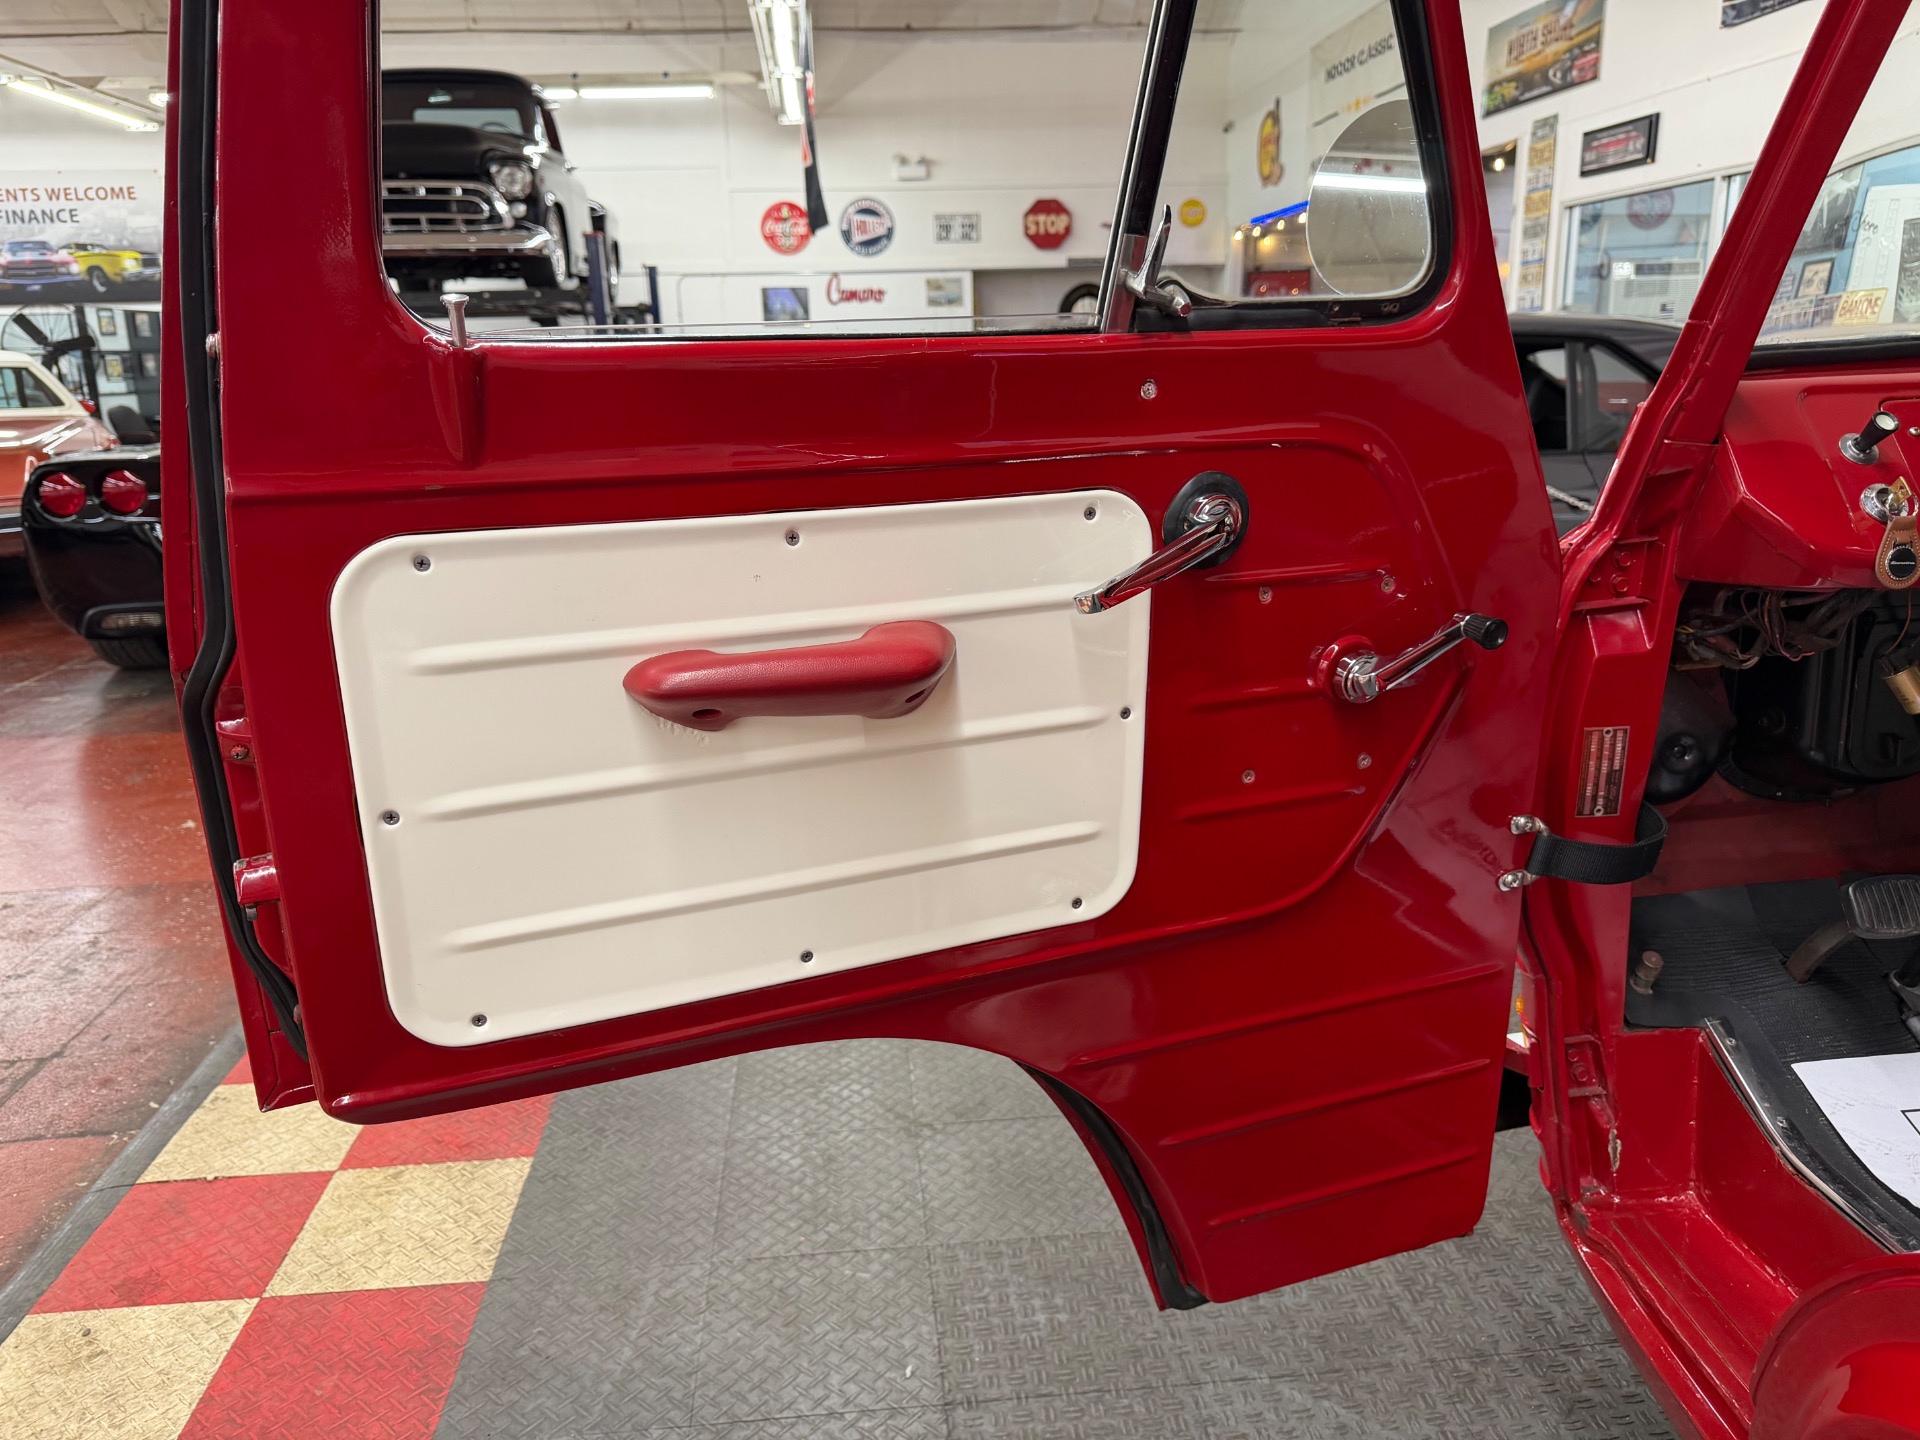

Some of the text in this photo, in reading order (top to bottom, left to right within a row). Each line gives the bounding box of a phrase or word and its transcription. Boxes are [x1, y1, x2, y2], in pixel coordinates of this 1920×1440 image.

[44, 186, 138, 203] WELCOME
[1026, 213, 1070, 236] STOP
[826, 273, 887, 305] Camaro
